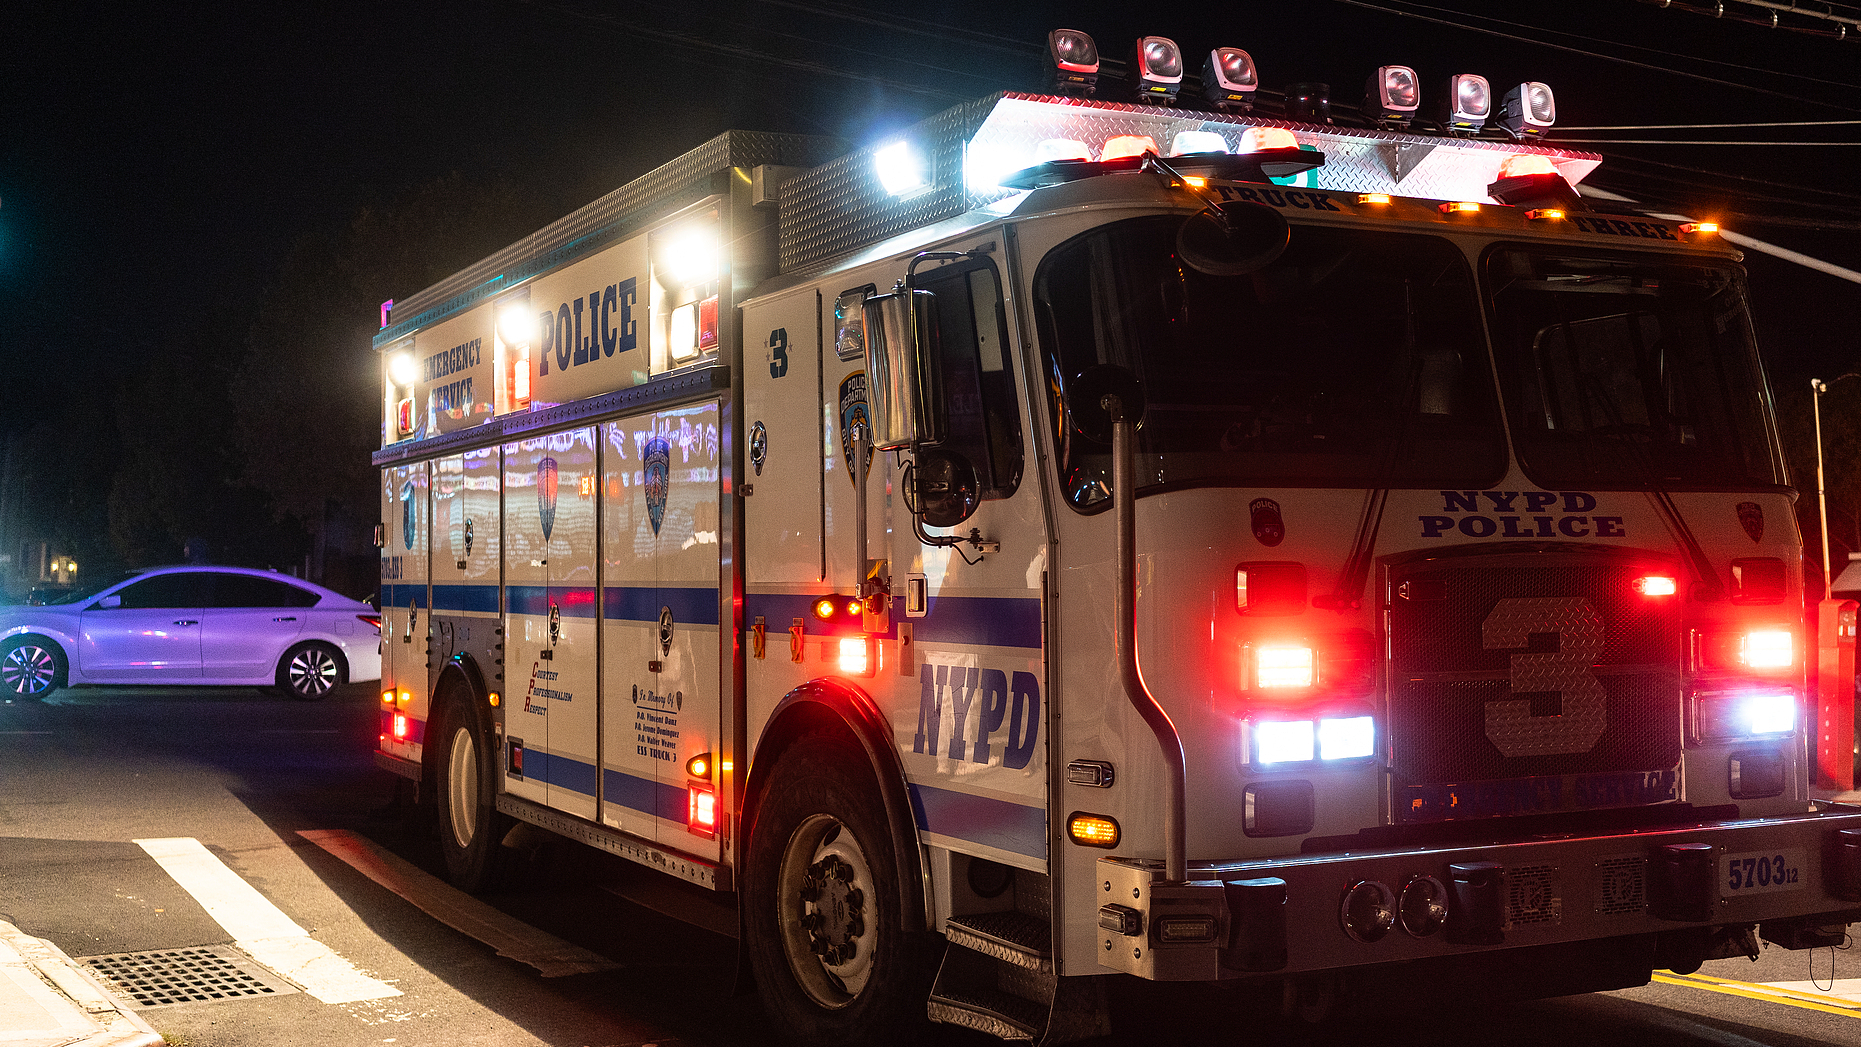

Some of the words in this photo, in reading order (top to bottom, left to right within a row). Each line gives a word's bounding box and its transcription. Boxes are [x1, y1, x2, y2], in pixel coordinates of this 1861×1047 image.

[1212, 184, 1341, 211] TRUCK
[1569, 216, 1679, 241] THREE
[539, 276, 637, 377] POLICE
[423, 337, 482, 384] EMERGENCY
[769, 328, 788, 379] 3
[431, 376, 473, 413] SERVICE
[847, 376, 867, 393] POLIC
[1252, 500, 1279, 514] POLICE
[1440, 490, 1597, 513] NYPD
[1418, 515, 1627, 538] POLICE
[1482, 597, 1607, 758] 3
[646, 713, 664, 724] Vincent
[664, 716, 677, 727] Danz
[913, 663, 1041, 771] NYPD
[636, 745, 647, 757] ESS
[649, 747, 670, 762] TRUCK
[672, 752, 677, 763] 3
[661, 738, 676, 750] Weaver
[1729, 855, 1785, 890] 5703
